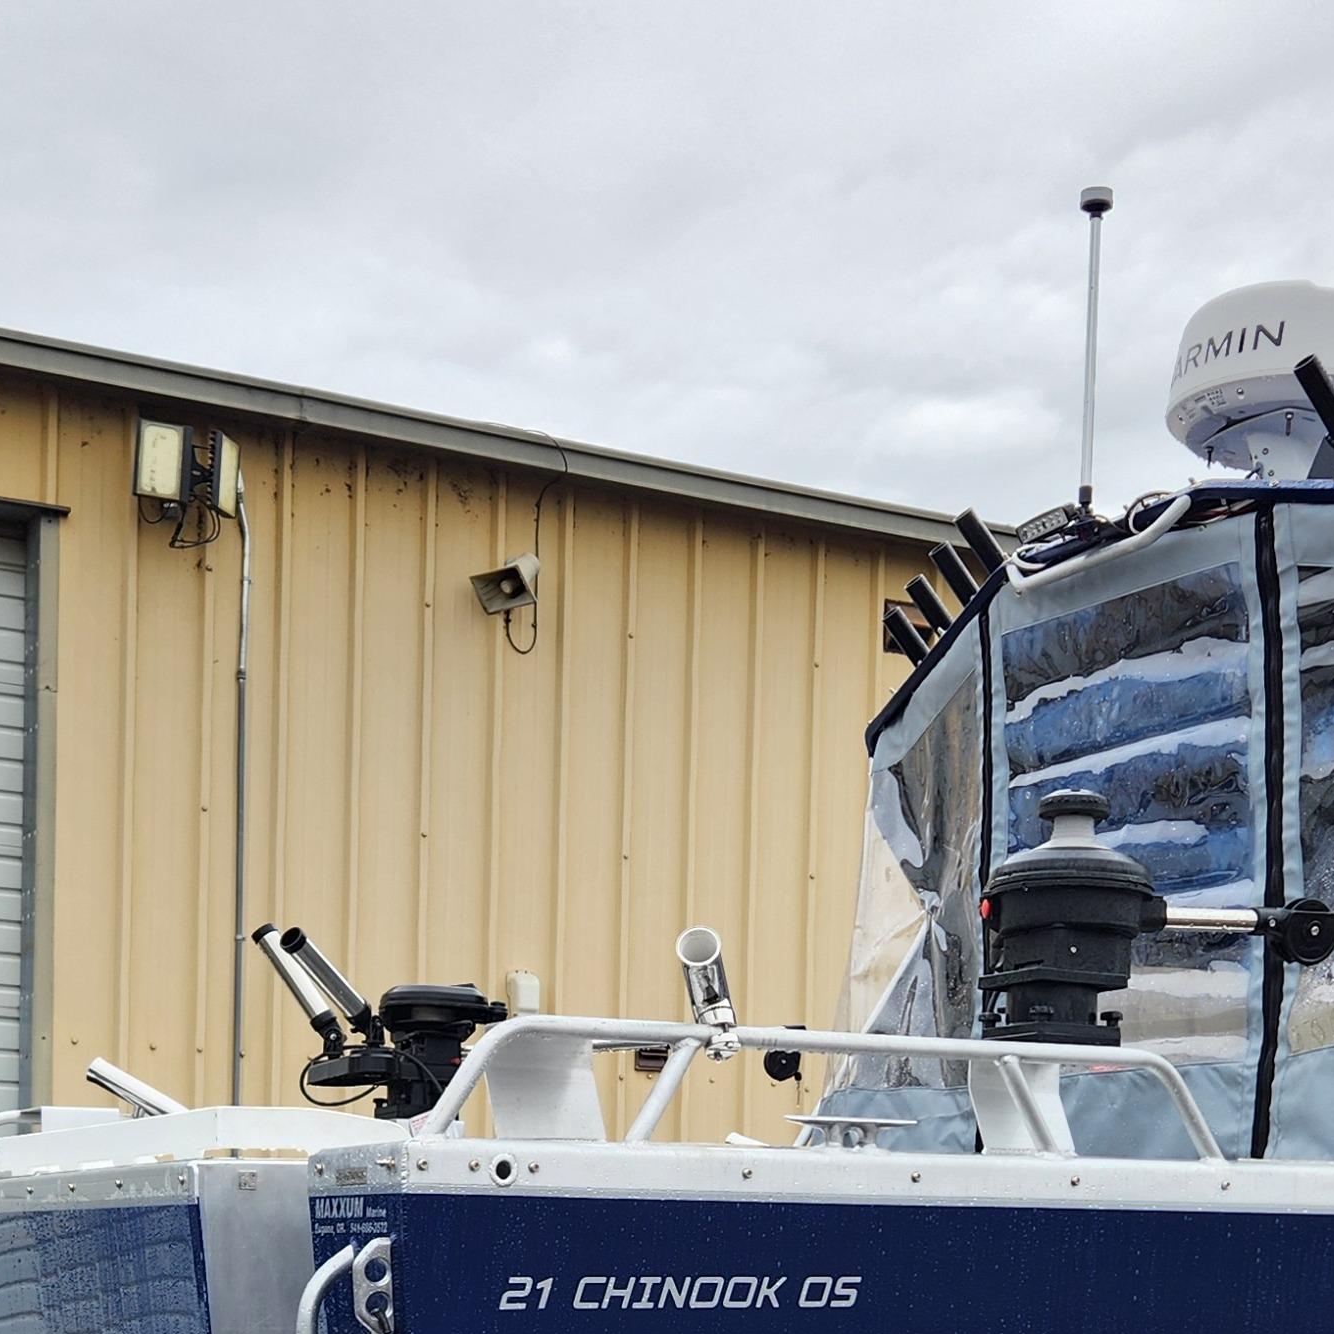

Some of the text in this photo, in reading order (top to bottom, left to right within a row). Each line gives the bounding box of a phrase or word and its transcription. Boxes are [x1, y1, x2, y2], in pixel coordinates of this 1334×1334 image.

[1170, 320, 1286, 386] ARMIN
[314, 1197, 387, 1219] MAXXUM Marine
[498, 1276, 863, 1310] 21 CHINOOK OS
